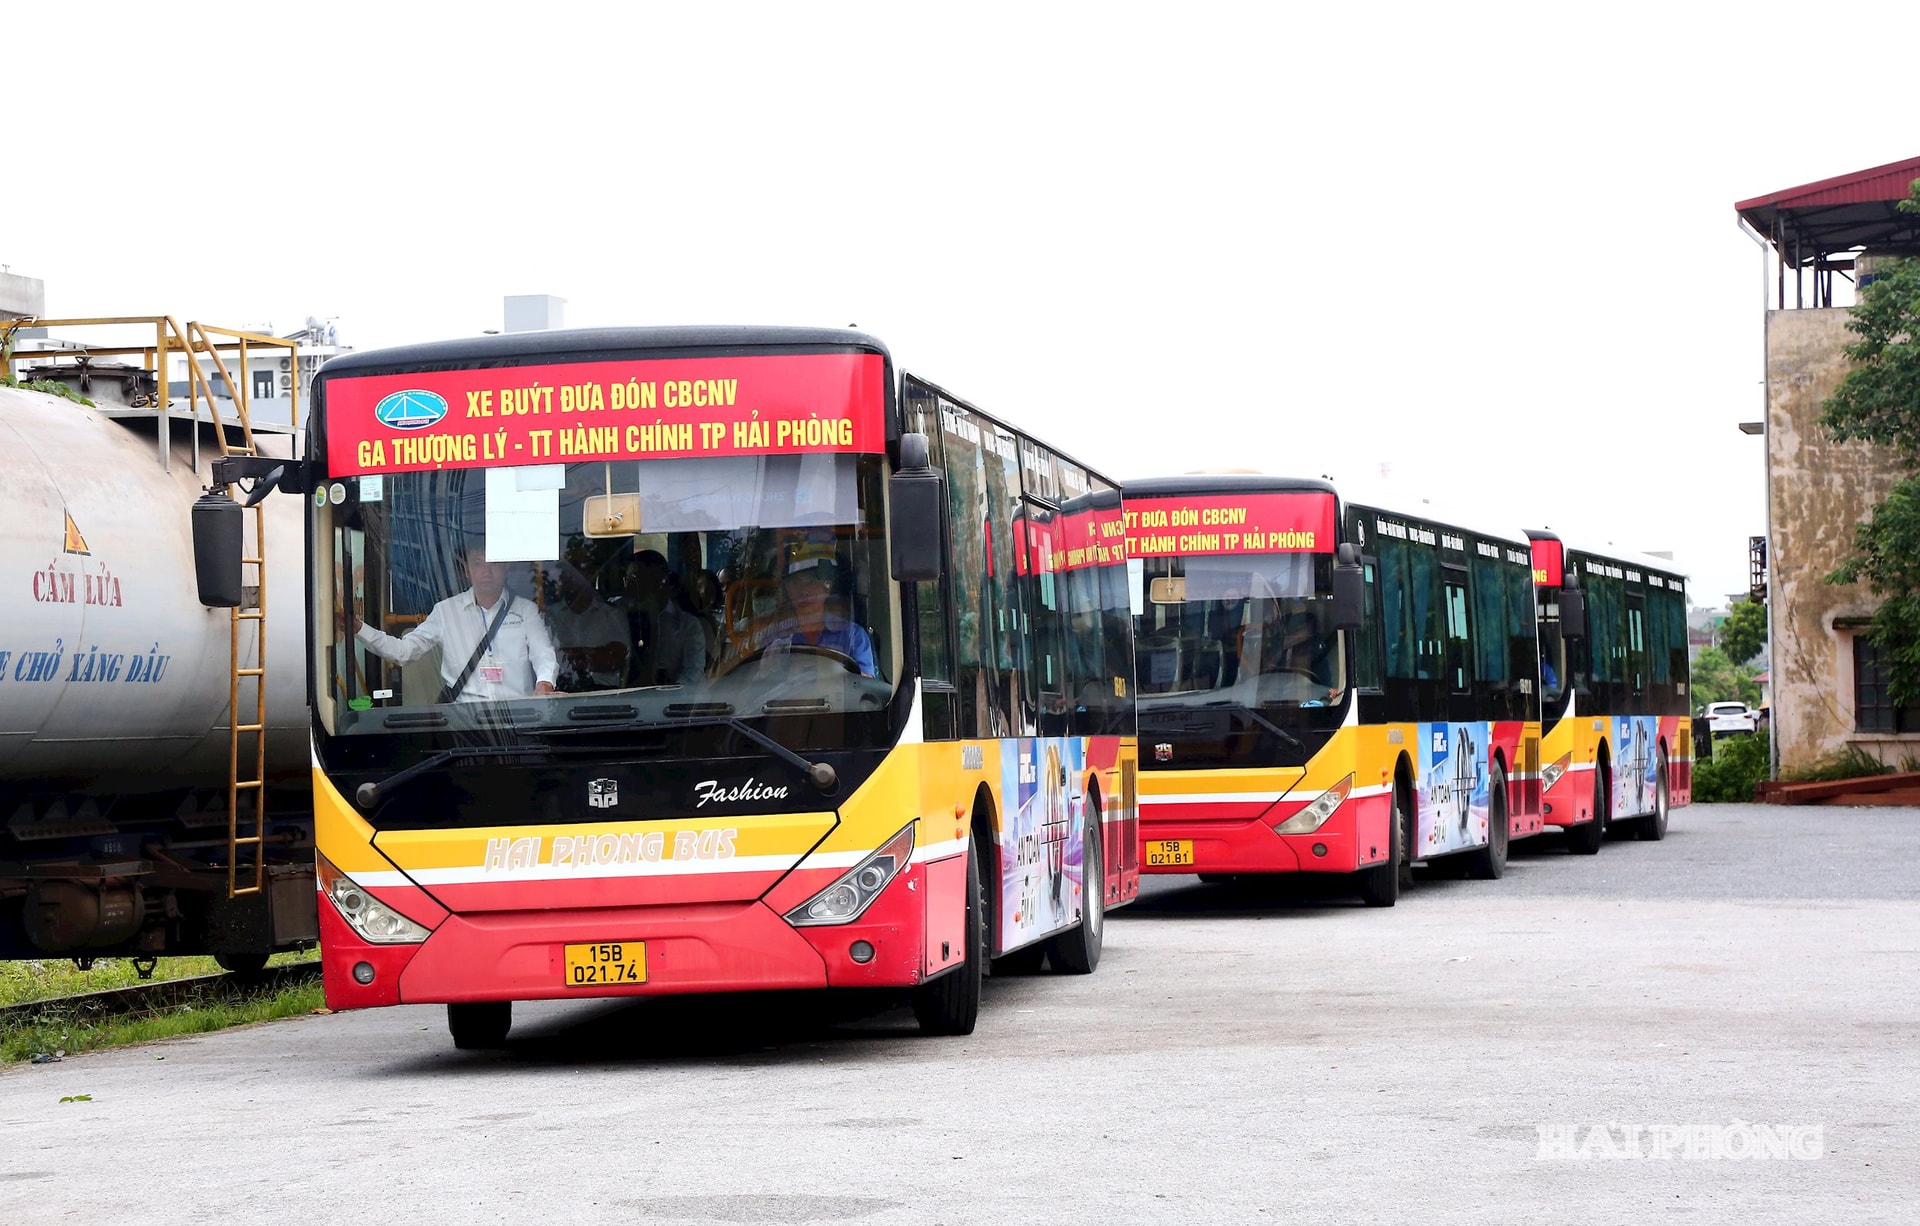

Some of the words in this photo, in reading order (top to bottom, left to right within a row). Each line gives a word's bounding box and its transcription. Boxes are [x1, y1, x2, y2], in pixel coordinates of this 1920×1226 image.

[466, 391, 493, 417] XE
[501, 382, 553, 416] BUÝT
[560, 382, 604, 412] ĐƯA
[611, 377, 656, 410] ĐÓN
[664, 379, 737, 407] CBCNV
[358, 440, 386, 467] GA
[392, 434, 476, 468] THƯỢNG
[483, 427, 507, 460] LÝ
[529, 430, 552, 457] TT
[559, 422, 619, 455] HÀNH
[626, 419, 693, 453] CHÍNH
[699, 423, 726, 449] TP
[733, 410, 770, 448] HẢI
[777, 413, 853, 447] PHÒNG
[1141, 509, 1168, 528] ĐƯA
[1171, 506, 1199, 526] ĐÓN
[1202, 508, 1247, 525] CBCNV
[1140, 533, 1176, 553] HÀNH
[1180, 531, 1220, 551] CHÍNH
[1223, 533, 1240, 550] TP
[1243, 526, 1265, 549] HẢI
[1269, 528, 1315, 549] PHÒNG
[33, 558, 75, 603] CẤM
[85, 561, 122, 607] LỬA
[15, 638, 64, 682] CHỞ
[66, 645, 124, 682] XĂNG
[125, 642, 170, 683] DẦU
[694, 778, 788, 808] Fashion
[485, 836, 542, 873] HAI
[551, 832, 665, 870] PHONG
[672, 828, 738, 862] BUS
[1151, 853, 1188, 864] 021.81
[1160, 841, 1180, 852] 15B
[590, 945, 622, 962] 15B
[574, 964, 637, 982] 021.74
